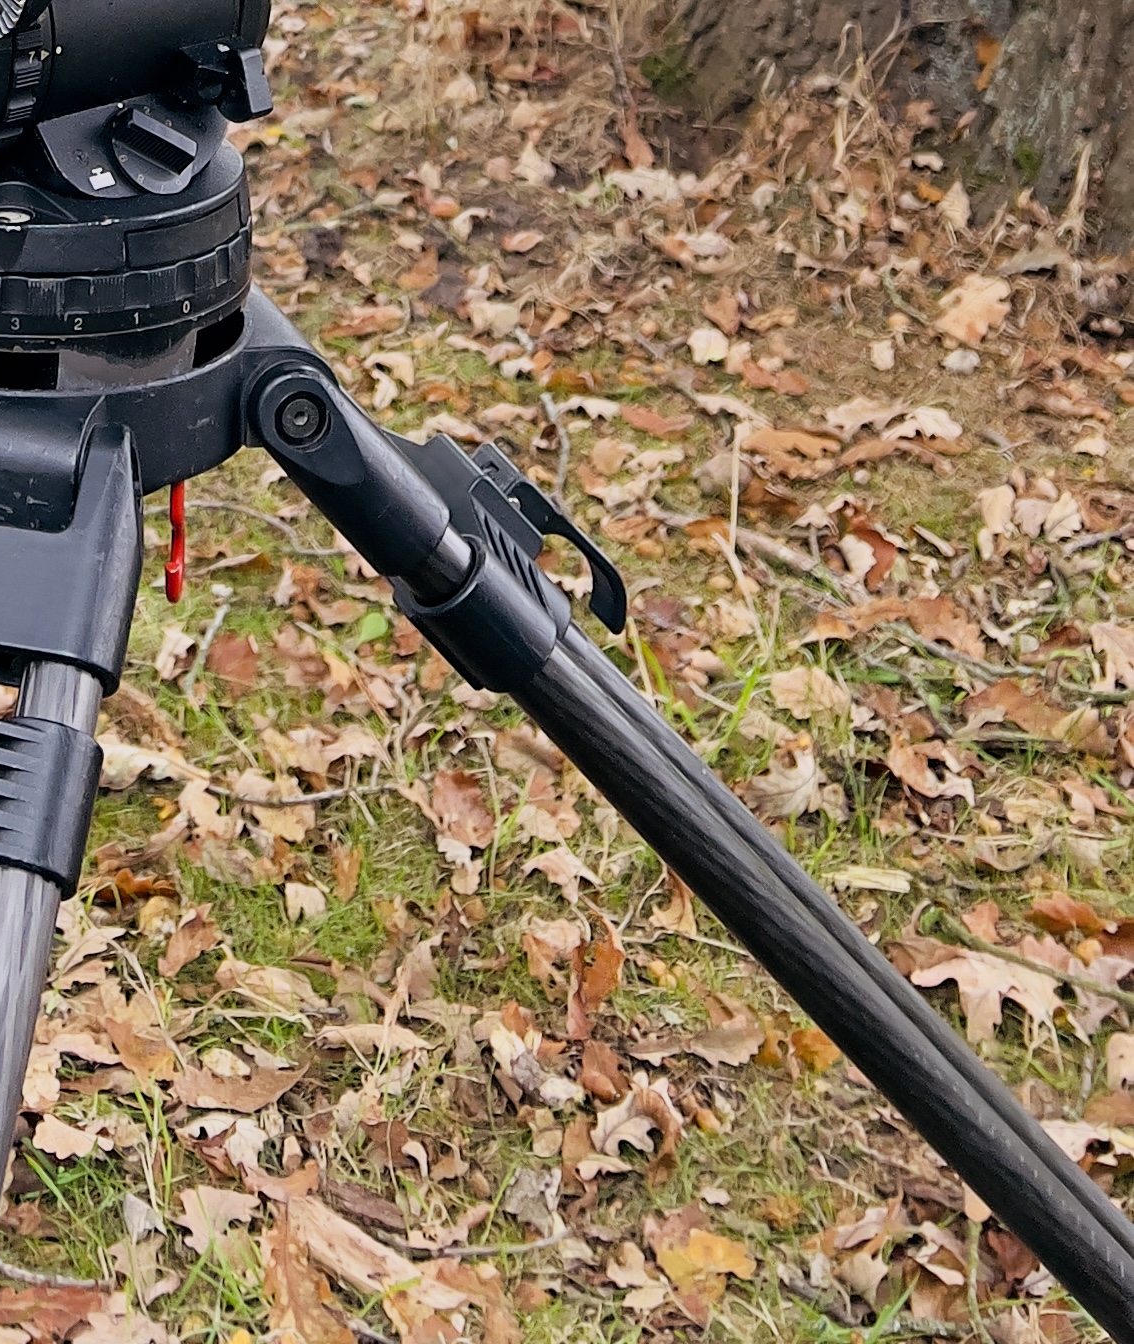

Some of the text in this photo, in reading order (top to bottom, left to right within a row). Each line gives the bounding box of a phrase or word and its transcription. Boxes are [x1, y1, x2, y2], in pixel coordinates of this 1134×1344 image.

[11, 318, 20, 331] 3
[73, 318, 83, 331] 2
[182, 301, 191, 314] 0
